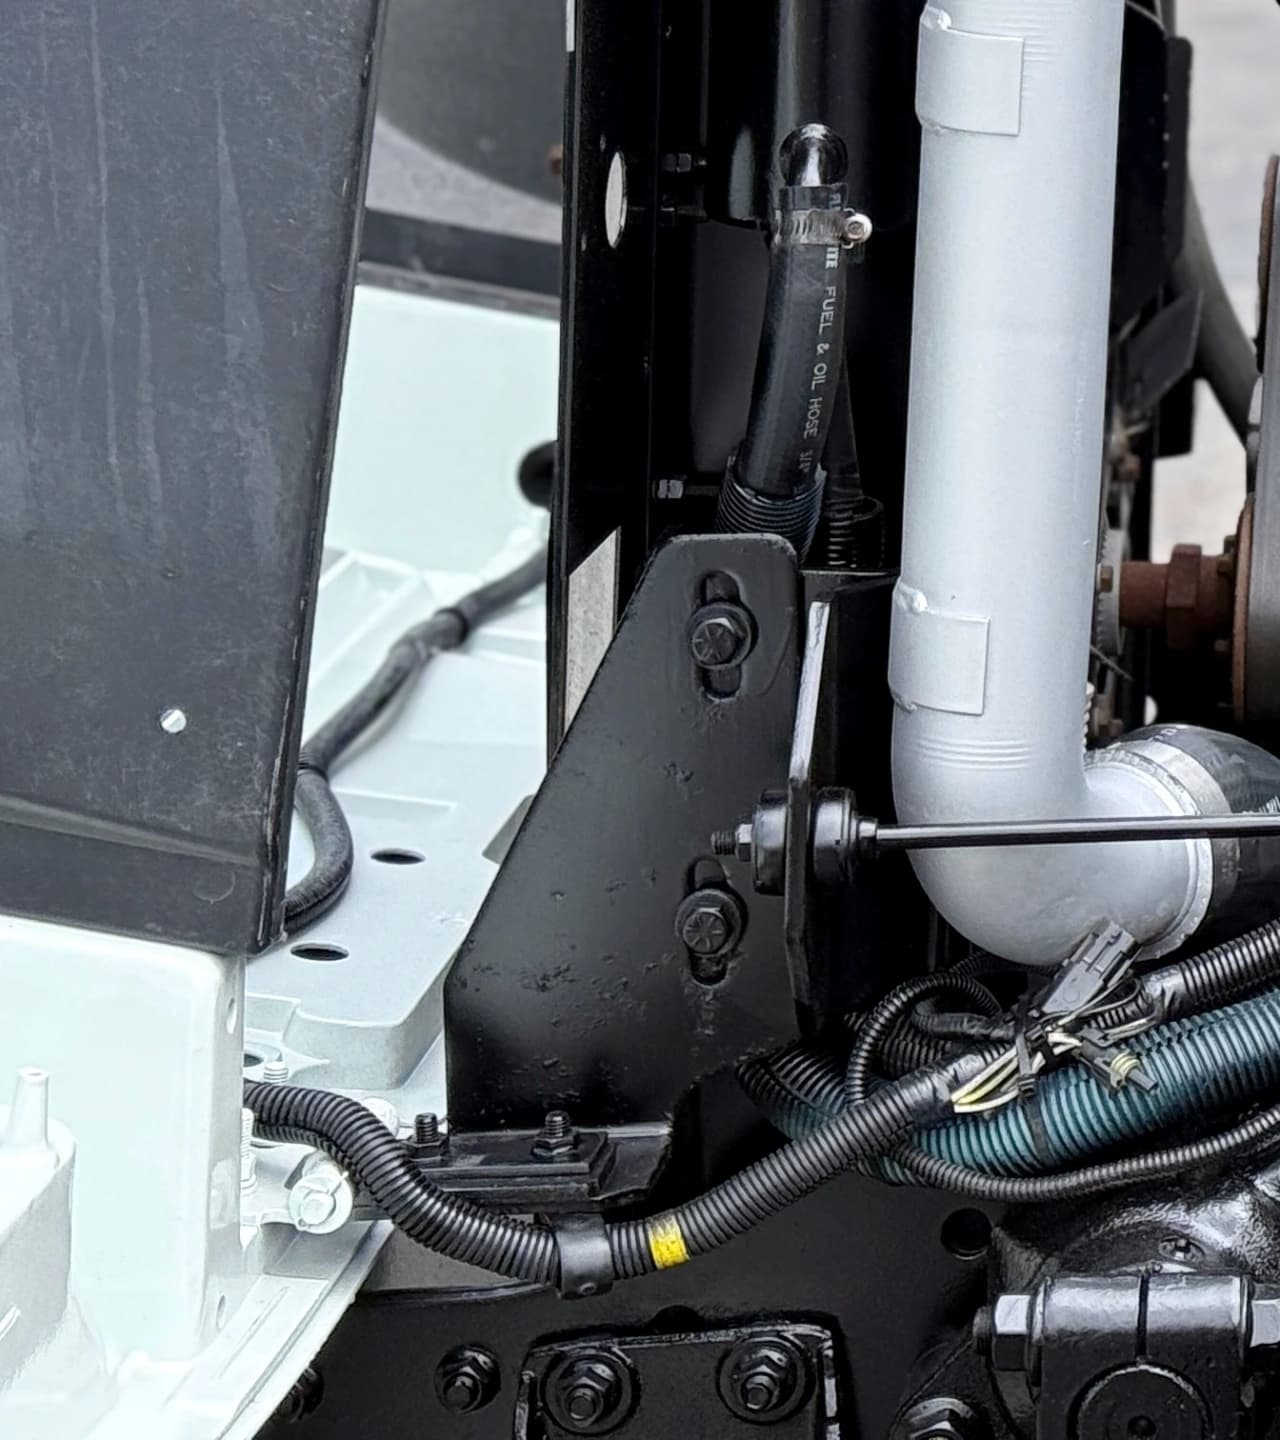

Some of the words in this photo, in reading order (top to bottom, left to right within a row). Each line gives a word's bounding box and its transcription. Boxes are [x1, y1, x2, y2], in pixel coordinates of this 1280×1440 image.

[818, 286, 837, 336] FUEL
[817, 343, 830, 355] &
[811, 363, 828, 391] OIL
[804, 397, 823, 439] HOSE
